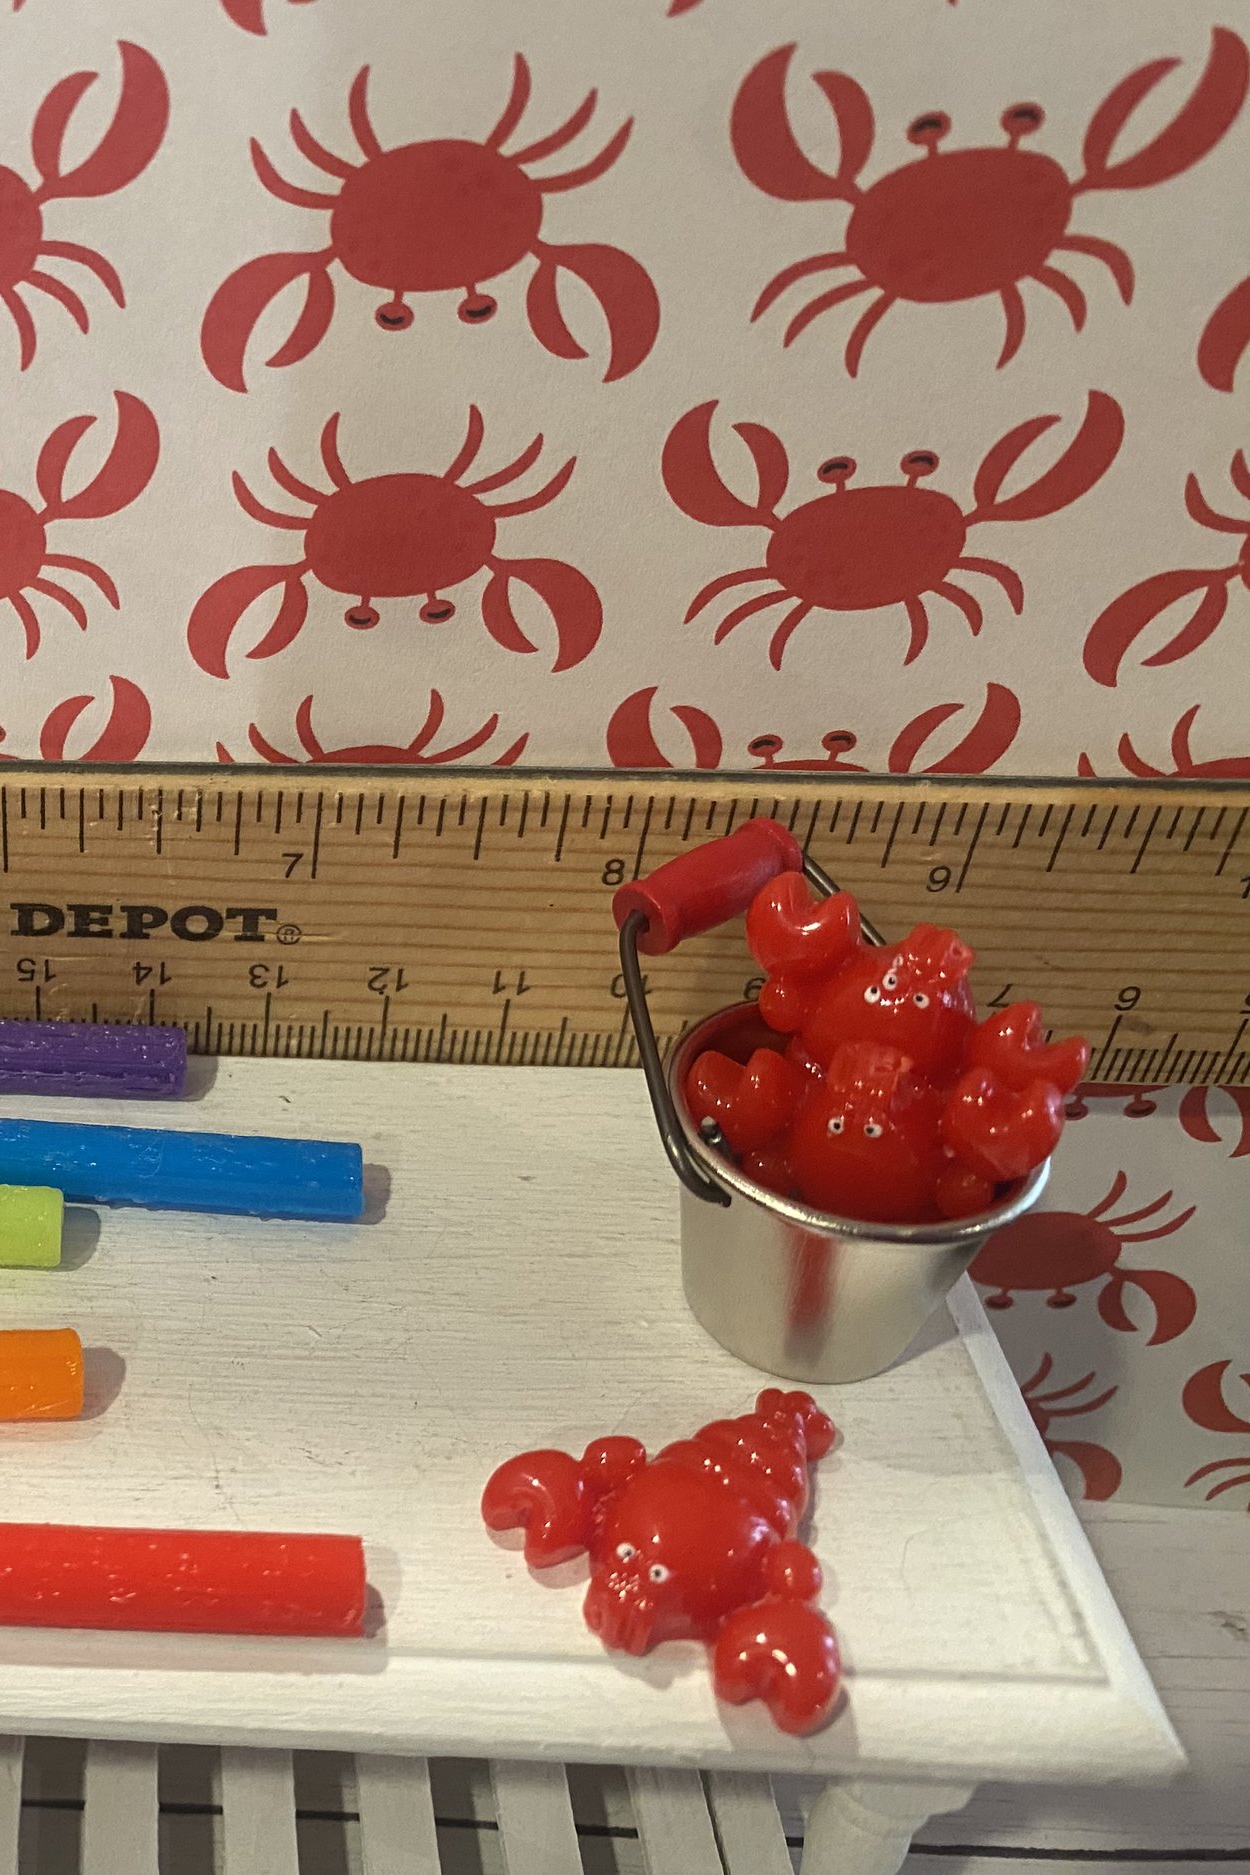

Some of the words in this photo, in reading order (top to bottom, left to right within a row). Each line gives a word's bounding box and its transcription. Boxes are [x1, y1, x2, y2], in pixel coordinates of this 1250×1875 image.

[281, 852, 304, 879] 7
[601, 858, 625, 886] 8
[926, 865, 952, 893] 9
[16, 958, 57, 983] 15
[132, 961, 172, 986] 14
[248, 963, 289, 989] 13
[367, 966, 409, 991] 12
[492, 970, 531, 996] 11
[986, 983, 1013, 1008] 7
